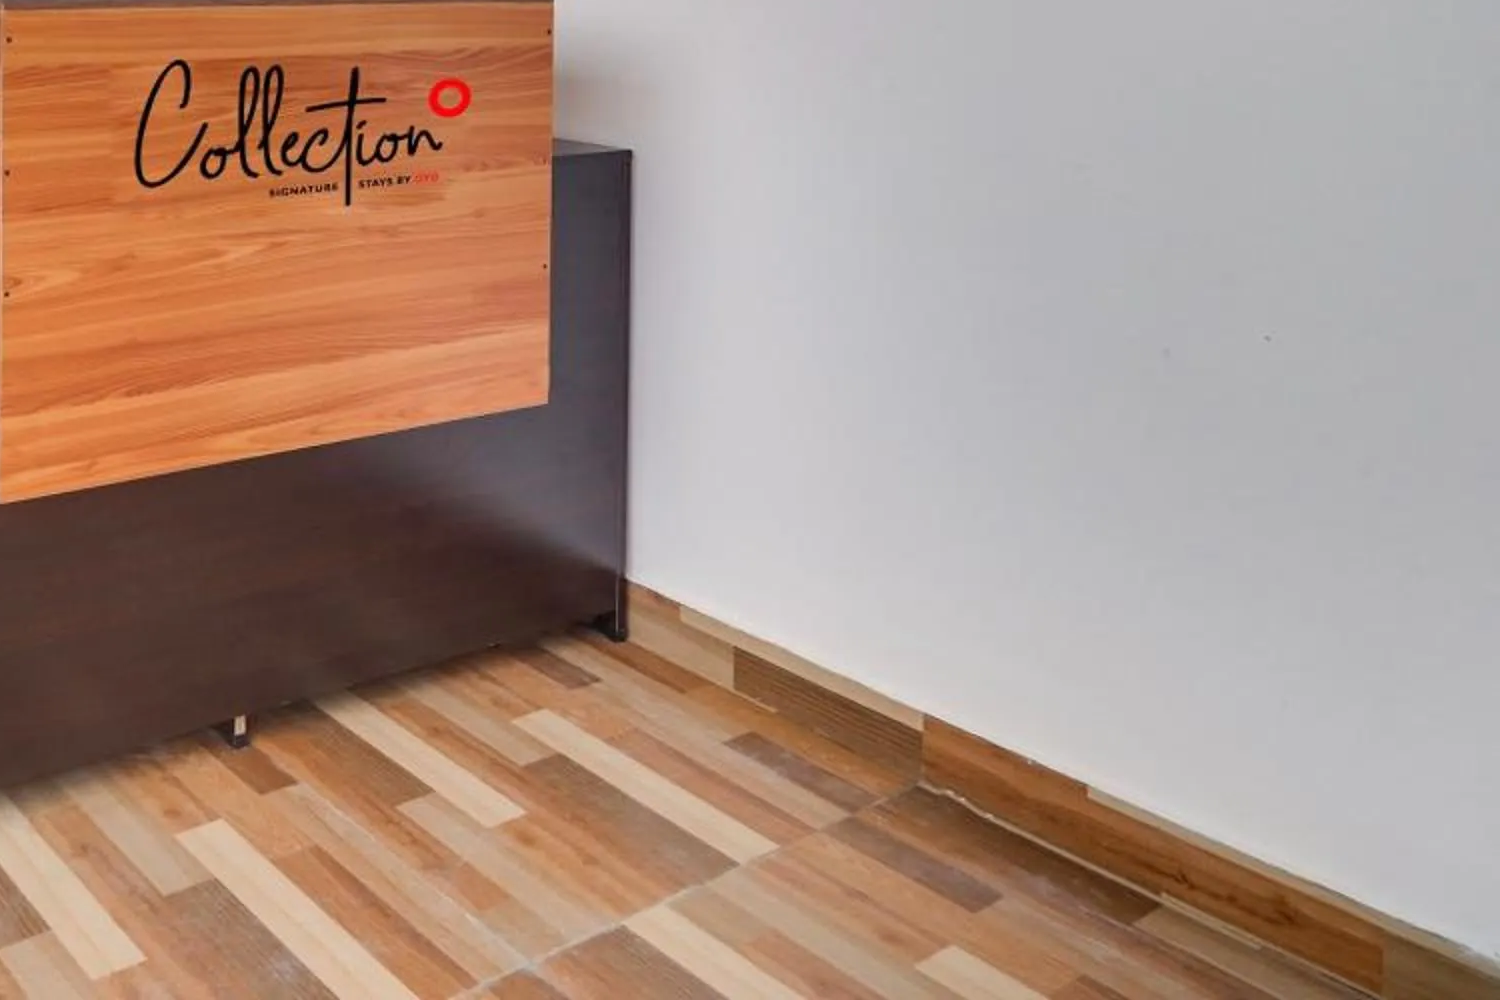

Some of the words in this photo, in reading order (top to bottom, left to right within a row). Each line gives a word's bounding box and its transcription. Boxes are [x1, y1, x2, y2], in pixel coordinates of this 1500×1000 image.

[134, 59, 443, 206] Collection
[269, 182, 339, 197] SIGNATURE
[358, 177, 393, 189] STAYS
[397, 175, 411, 185] BY
